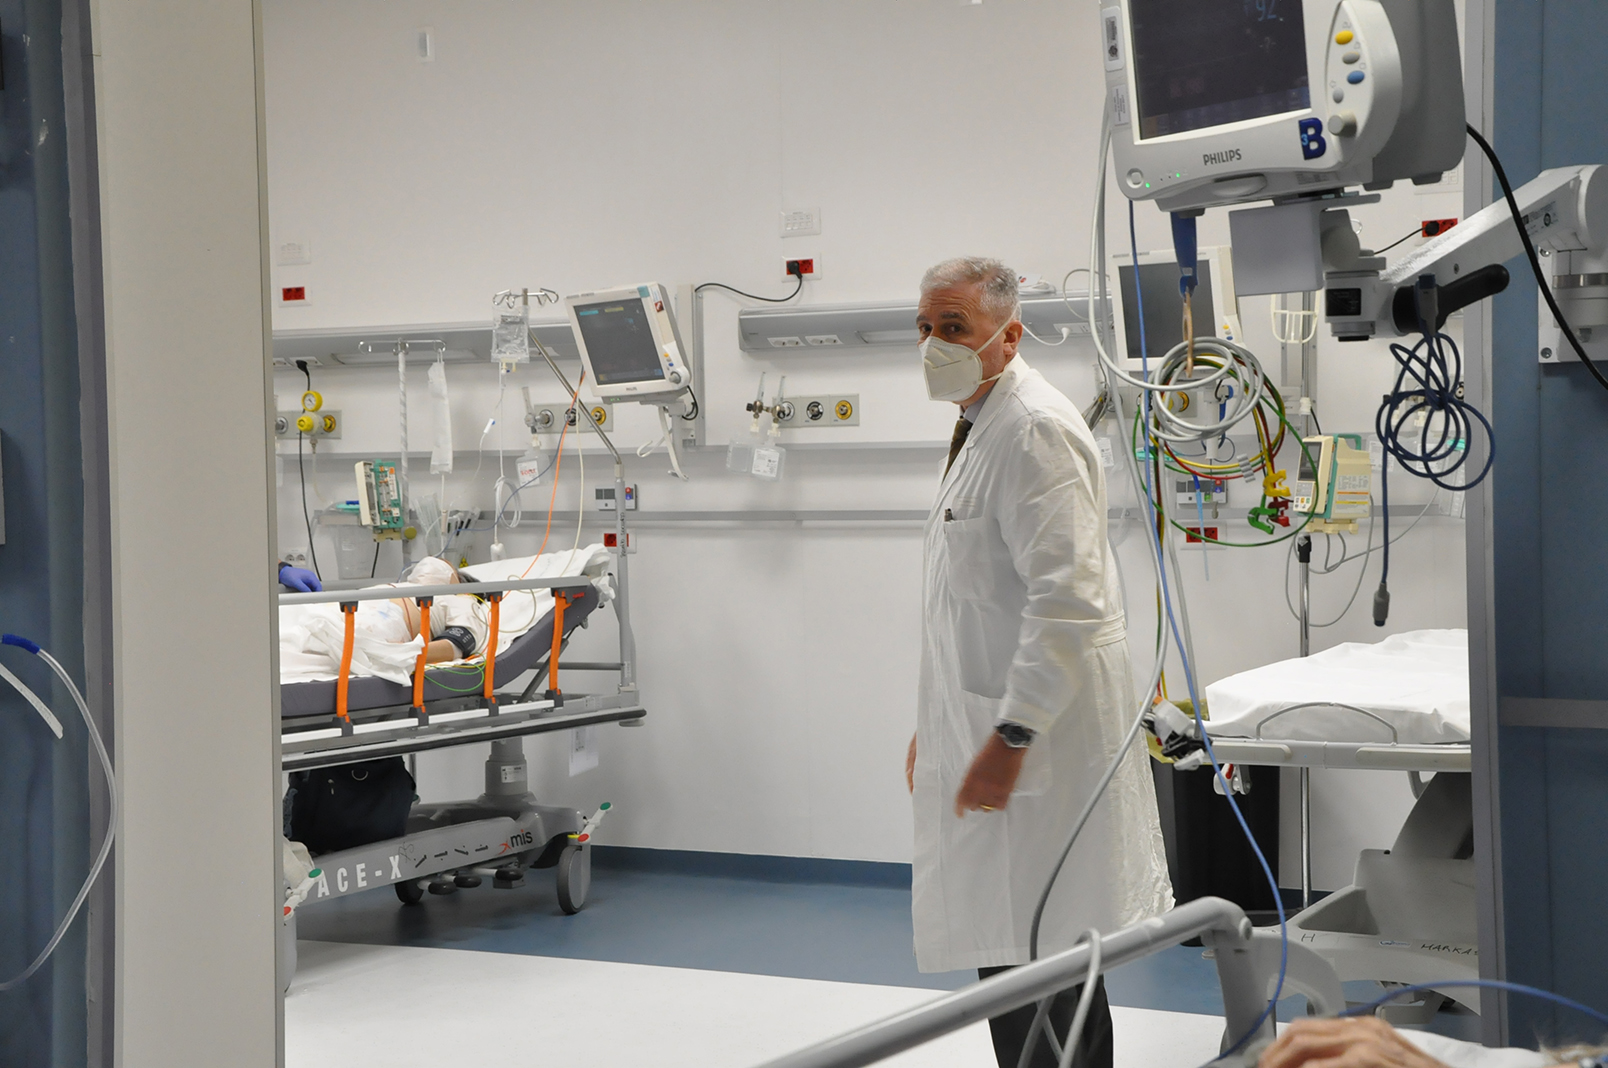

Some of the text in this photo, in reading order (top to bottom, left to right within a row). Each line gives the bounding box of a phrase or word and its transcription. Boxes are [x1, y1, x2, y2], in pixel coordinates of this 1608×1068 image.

[1298, 117, 1327, 160] B
[1301, 133, 1309, 146] 3
[1203, 148, 1242, 165] PHILIPS
